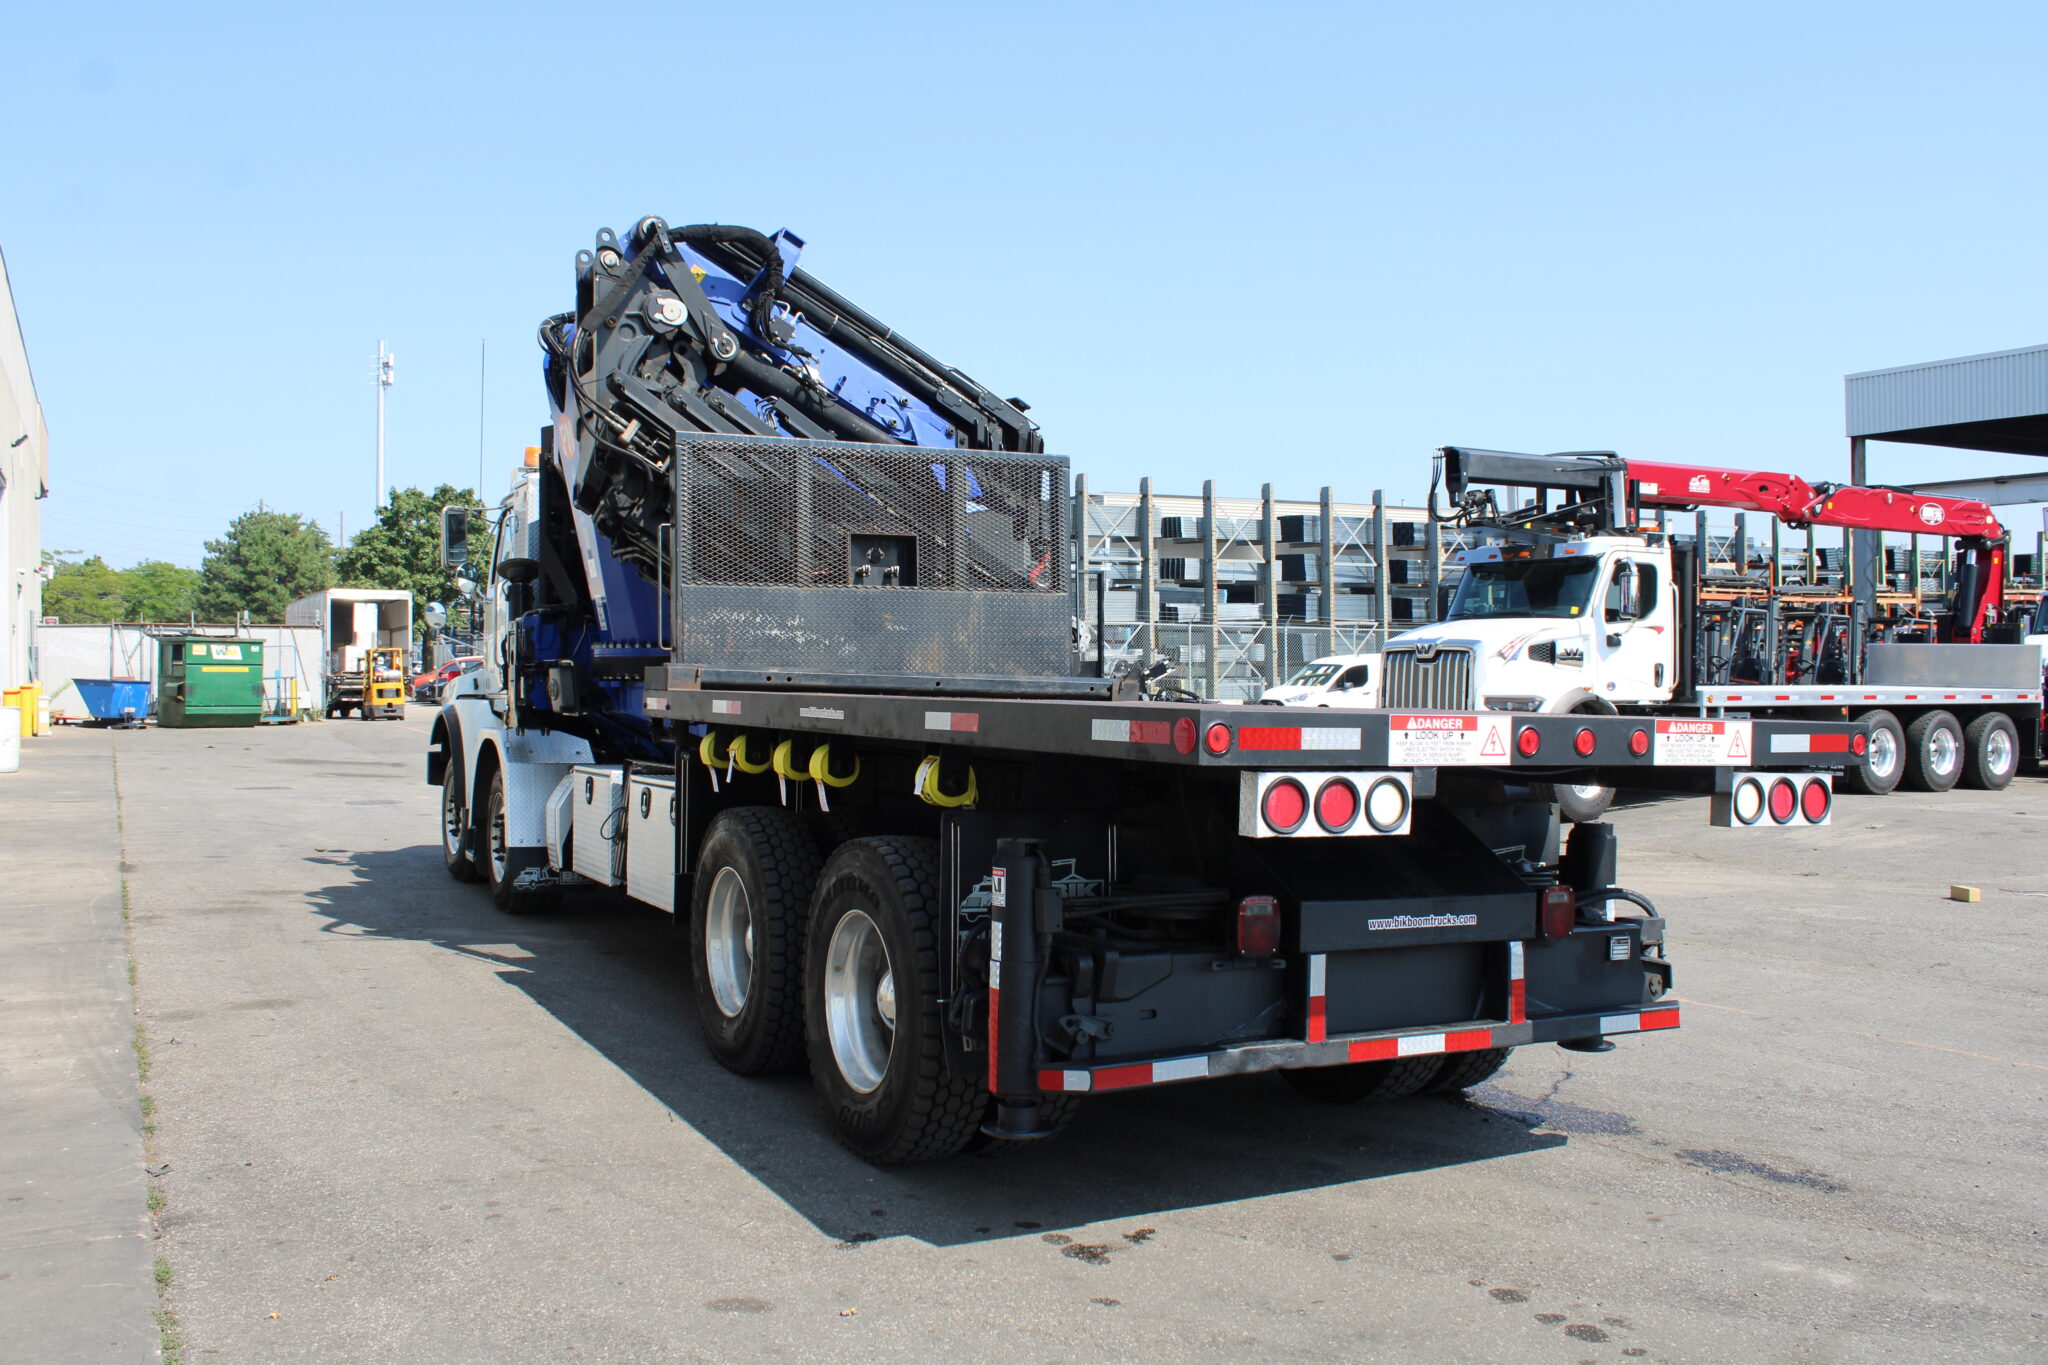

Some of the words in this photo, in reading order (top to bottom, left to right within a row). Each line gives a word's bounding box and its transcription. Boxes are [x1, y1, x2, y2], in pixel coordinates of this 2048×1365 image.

[1417, 718, 1463, 729] DANGER
[1676, 723, 1714, 733] DANGER
[1415, 731, 1440, 740] LOOK
[1442, 731, 1454, 740] UP
[1675, 734, 1694, 742] LOOK
[1696, 734, 1706, 742] UP
[1368, 914, 1477, 930] www.bikboomtrucks.com
